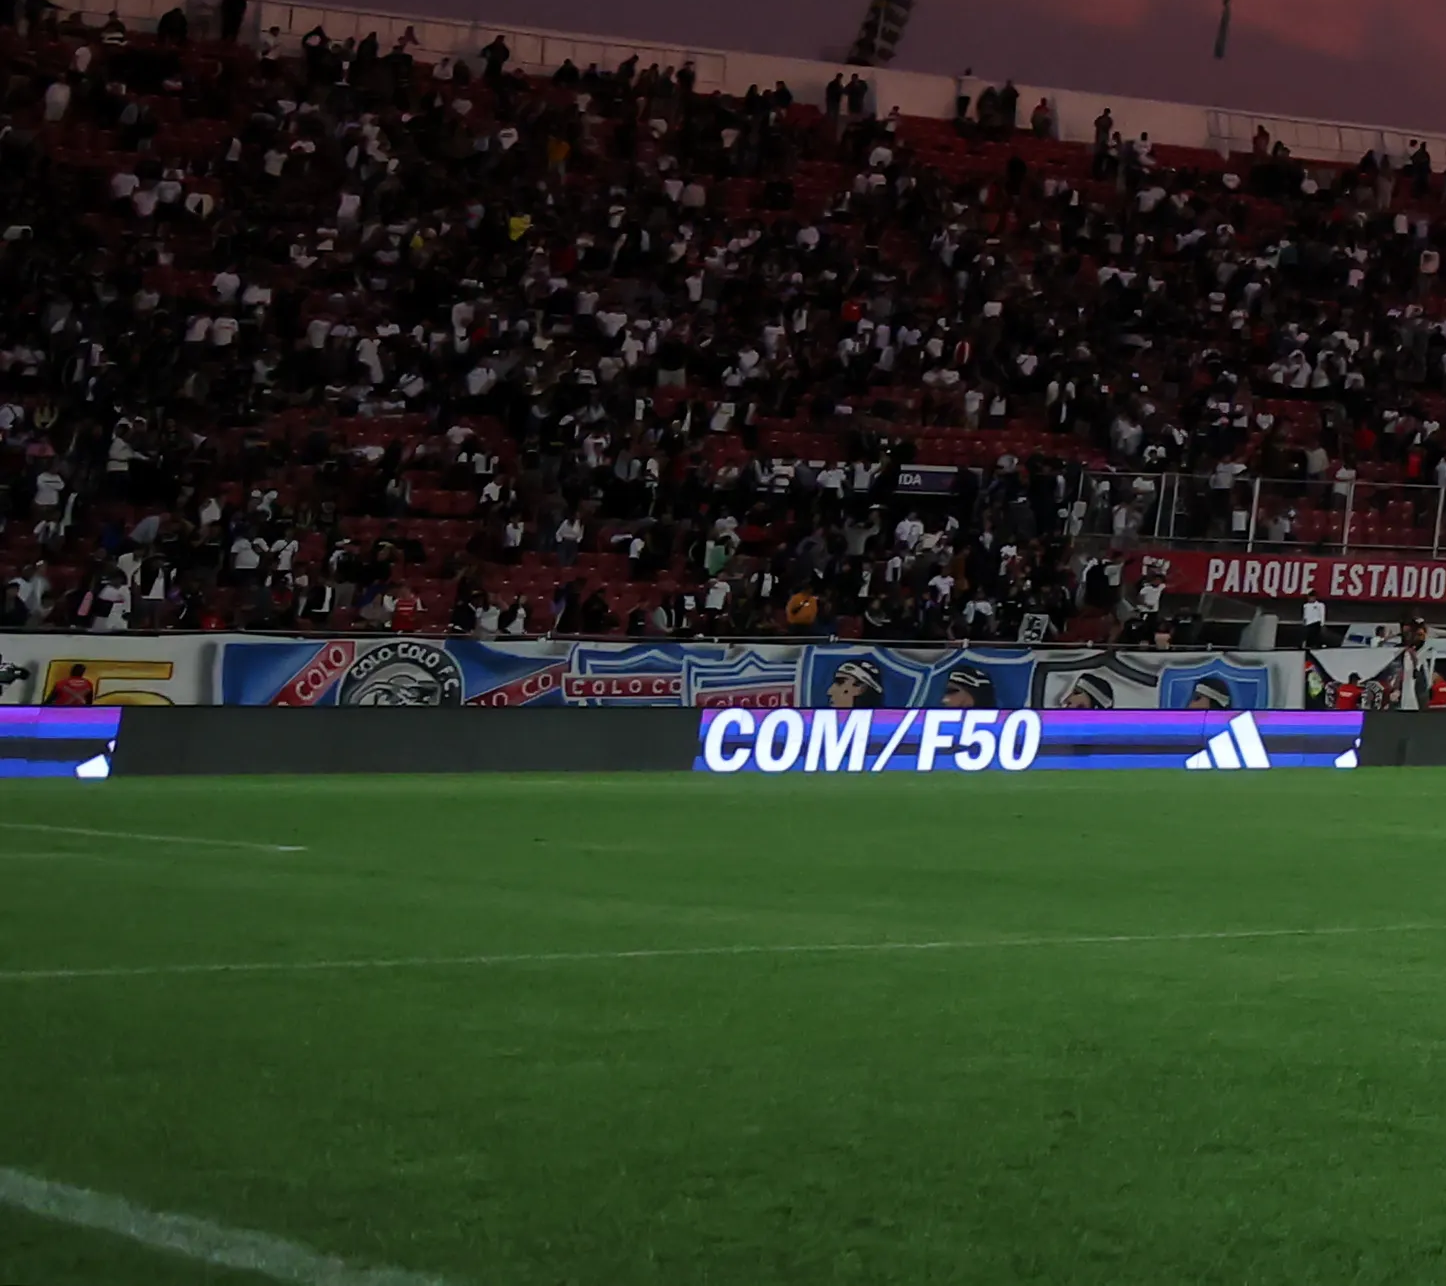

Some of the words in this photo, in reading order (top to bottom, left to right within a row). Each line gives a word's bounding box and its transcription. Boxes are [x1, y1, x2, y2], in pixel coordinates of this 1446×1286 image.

[1205, 557, 1319, 599] PARQUE
[572, 679, 643, 695] COLO
[704, 707, 1042, 773] COM/F50
